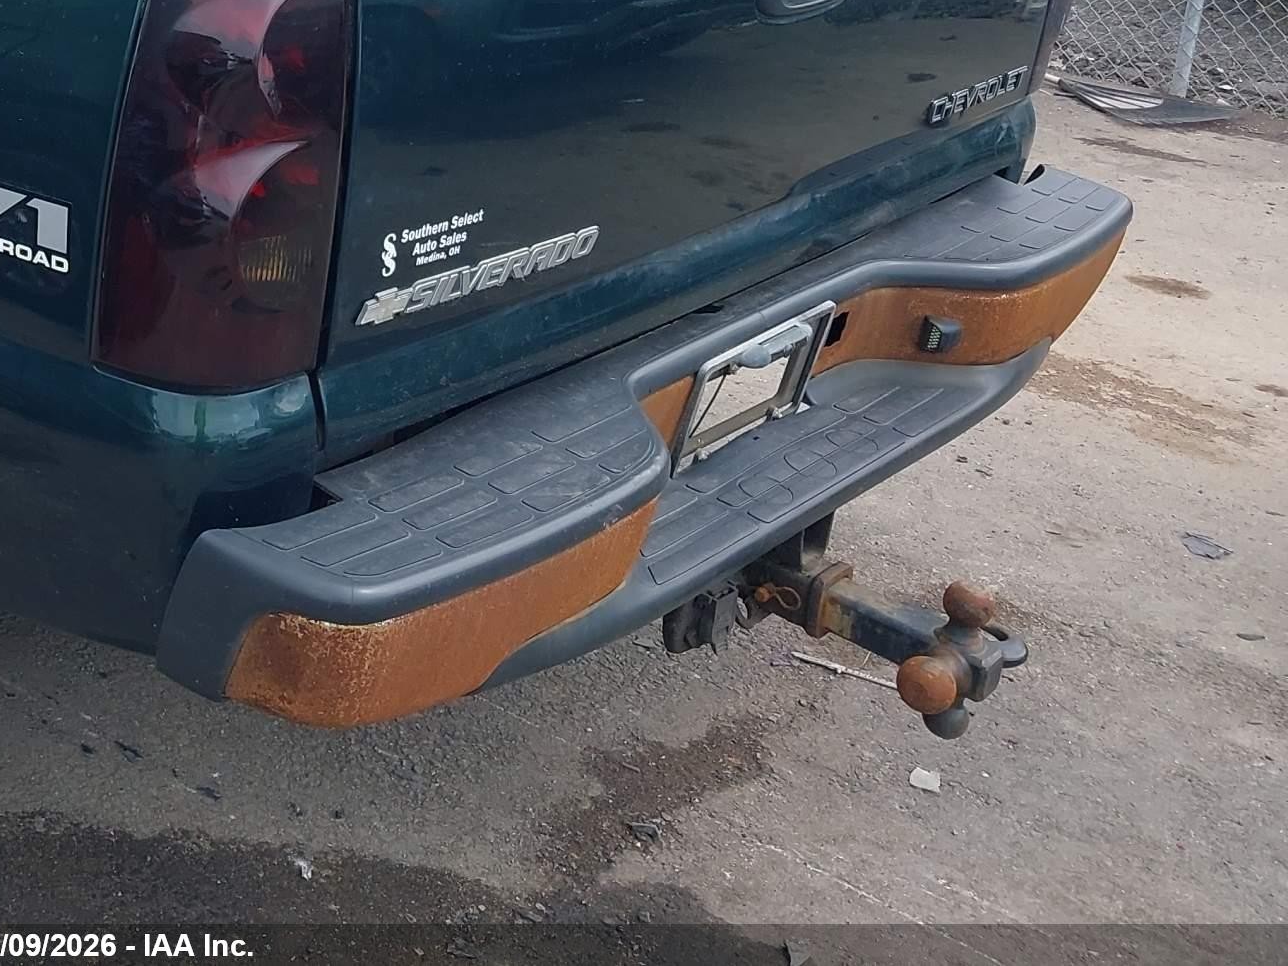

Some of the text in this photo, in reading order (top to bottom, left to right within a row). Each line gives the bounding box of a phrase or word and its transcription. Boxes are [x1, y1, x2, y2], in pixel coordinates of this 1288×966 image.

[929, 65, 1029, 125] CHEVROLET
[400, 208, 484, 244] Southern Select
[412, 231, 467, 256] Auto Sales
[404, 225, 600, 314] SILVERADO
[415, 245, 461, 267] Medina, OH
